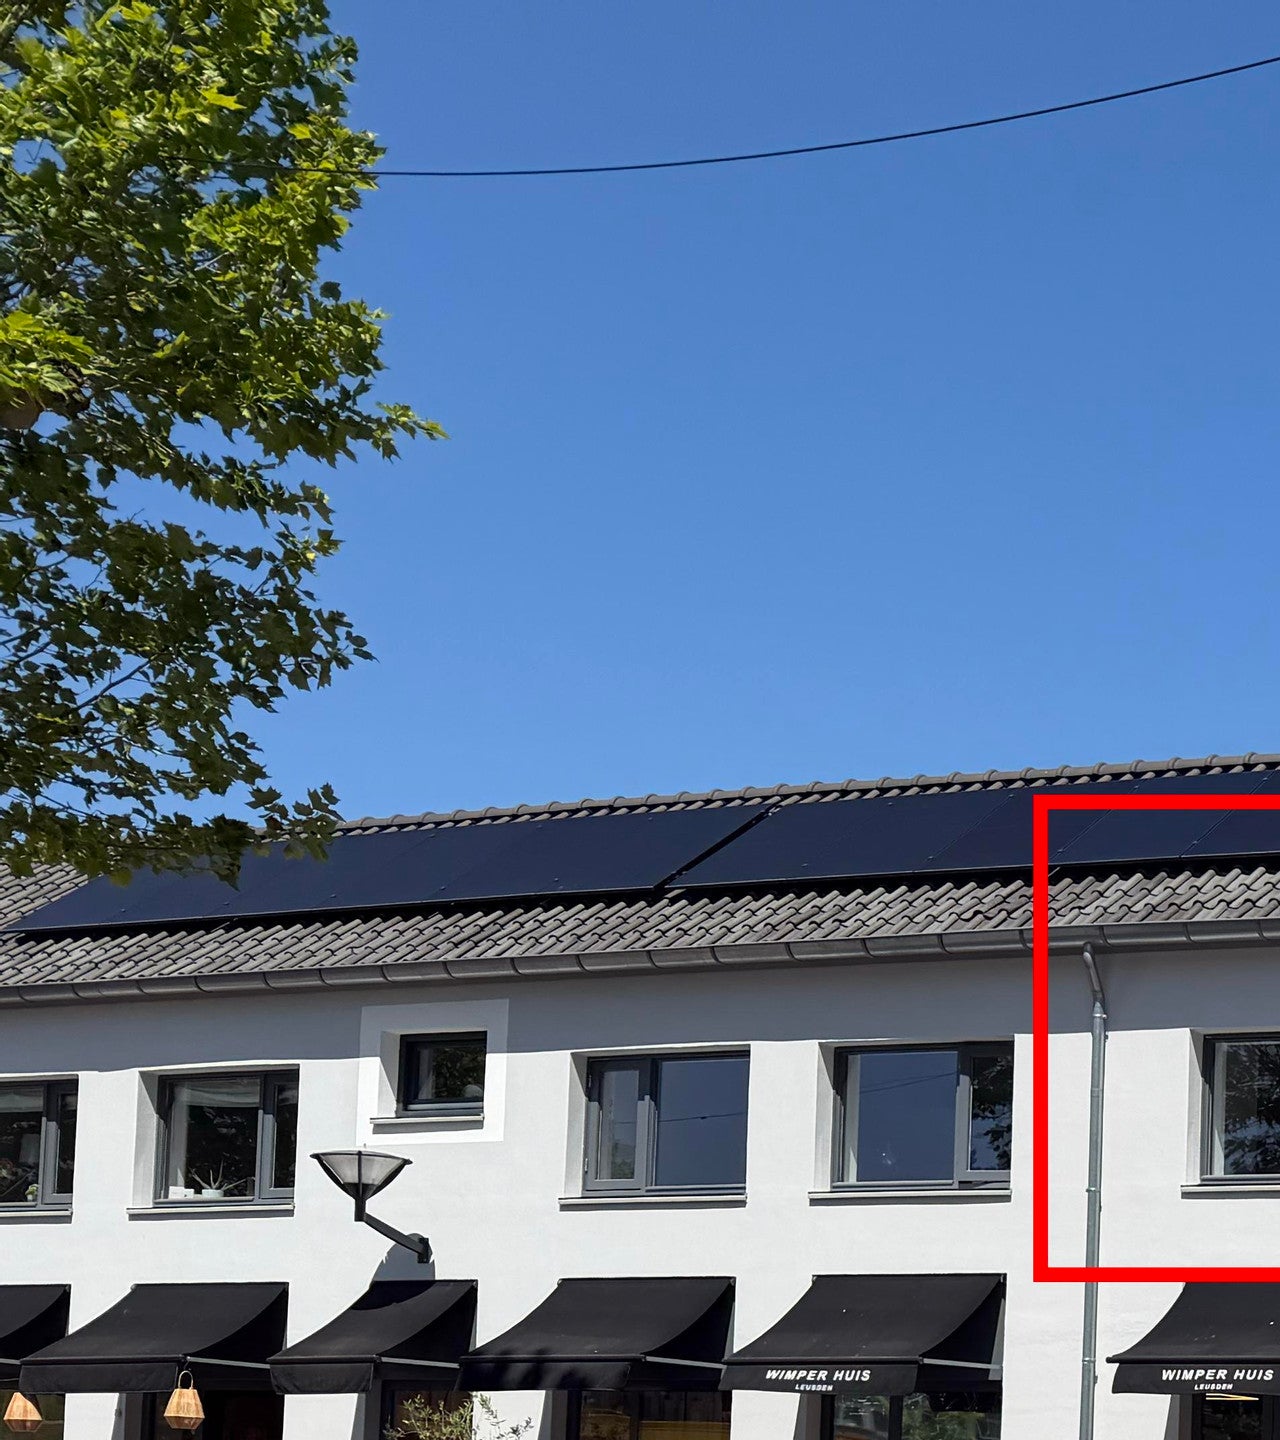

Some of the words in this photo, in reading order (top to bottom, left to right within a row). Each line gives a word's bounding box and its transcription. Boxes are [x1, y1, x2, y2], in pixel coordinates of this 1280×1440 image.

[765, 1369, 829, 1381] WIMPER
[832, 1369, 871, 1381] HUIS
[1161, 1369, 1228, 1381] WIMPER
[1233, 1369, 1274, 1381] HUIS
